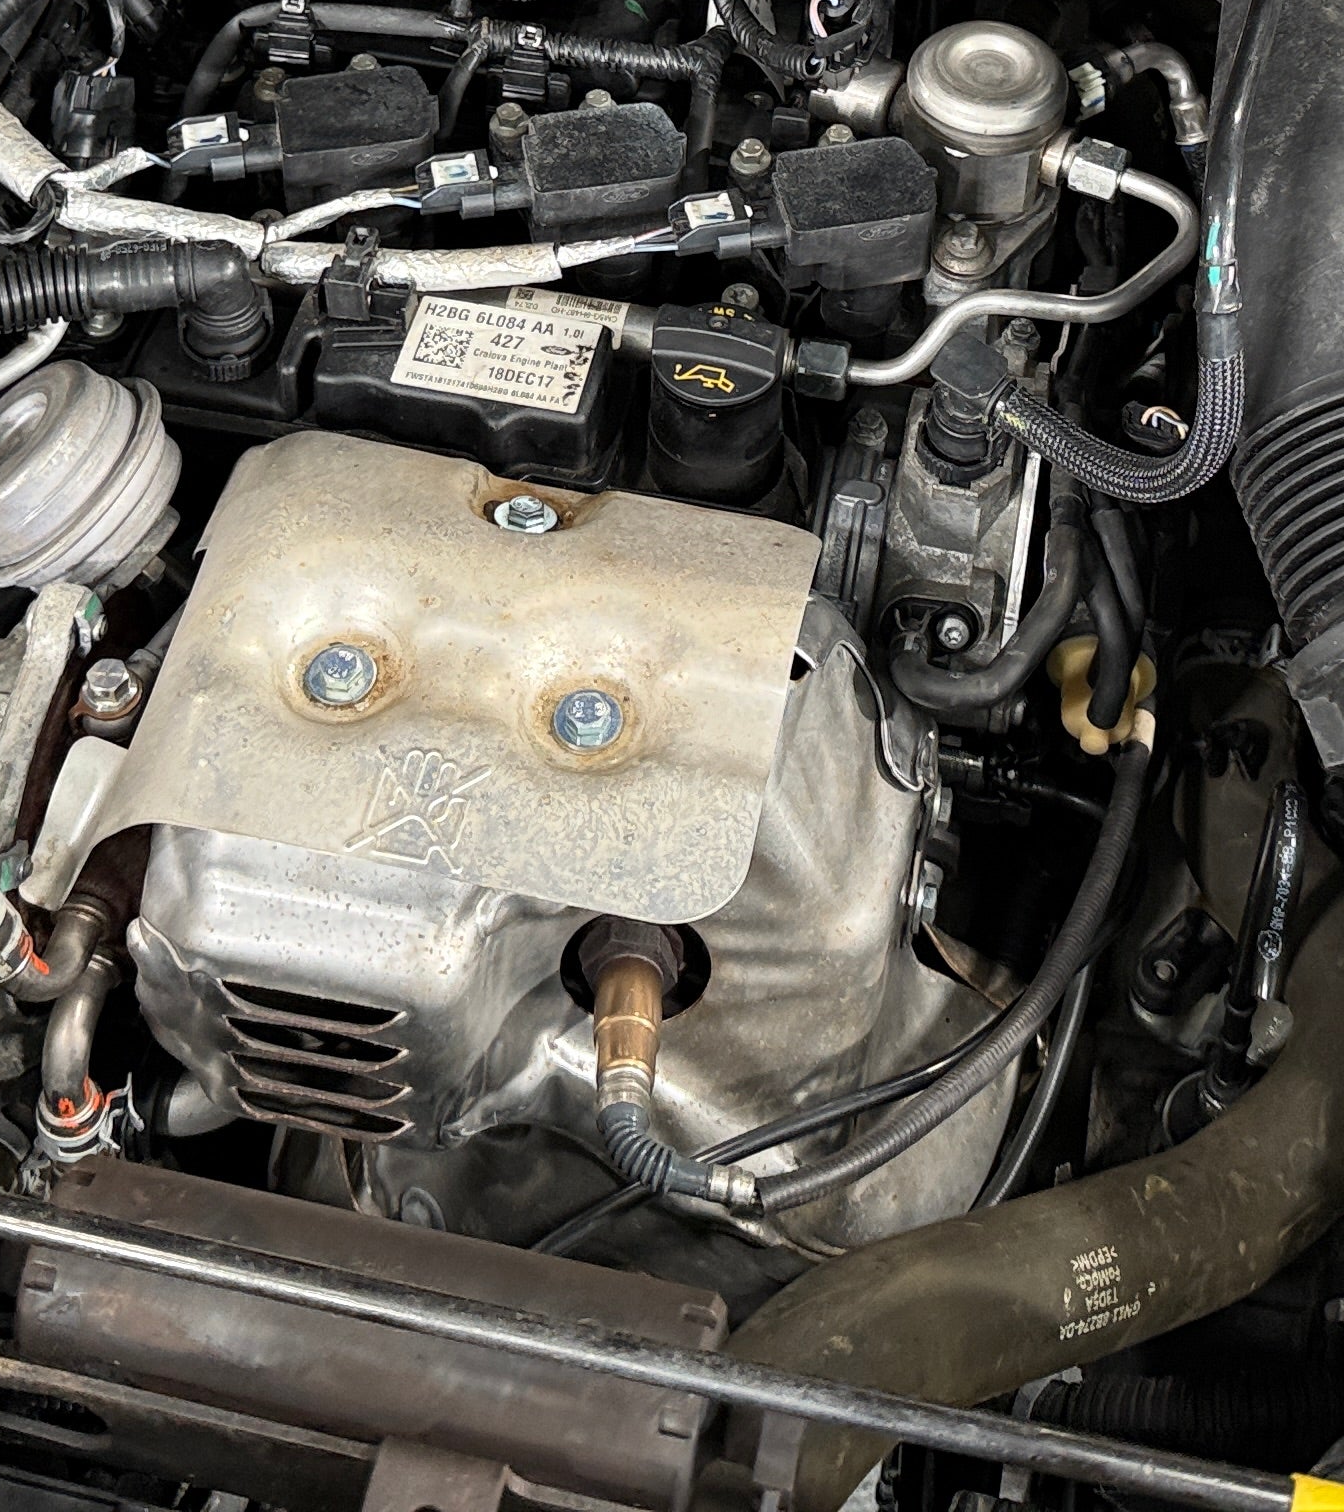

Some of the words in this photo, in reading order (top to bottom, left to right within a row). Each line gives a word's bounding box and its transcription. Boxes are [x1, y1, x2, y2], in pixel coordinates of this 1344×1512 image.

[424, 302, 470, 322] H2BG
[475, 311, 527, 332] 6L084
[530, 320, 555, 336] AA
[490, 332, 525, 351] 427
[509, 354, 541, 369] Engine
[543, 360, 569, 372] Plant
[487, 365, 555, 390] 18DEC17
[536, 394, 547, 402] AA
[550, 396, 560, 404] FA
